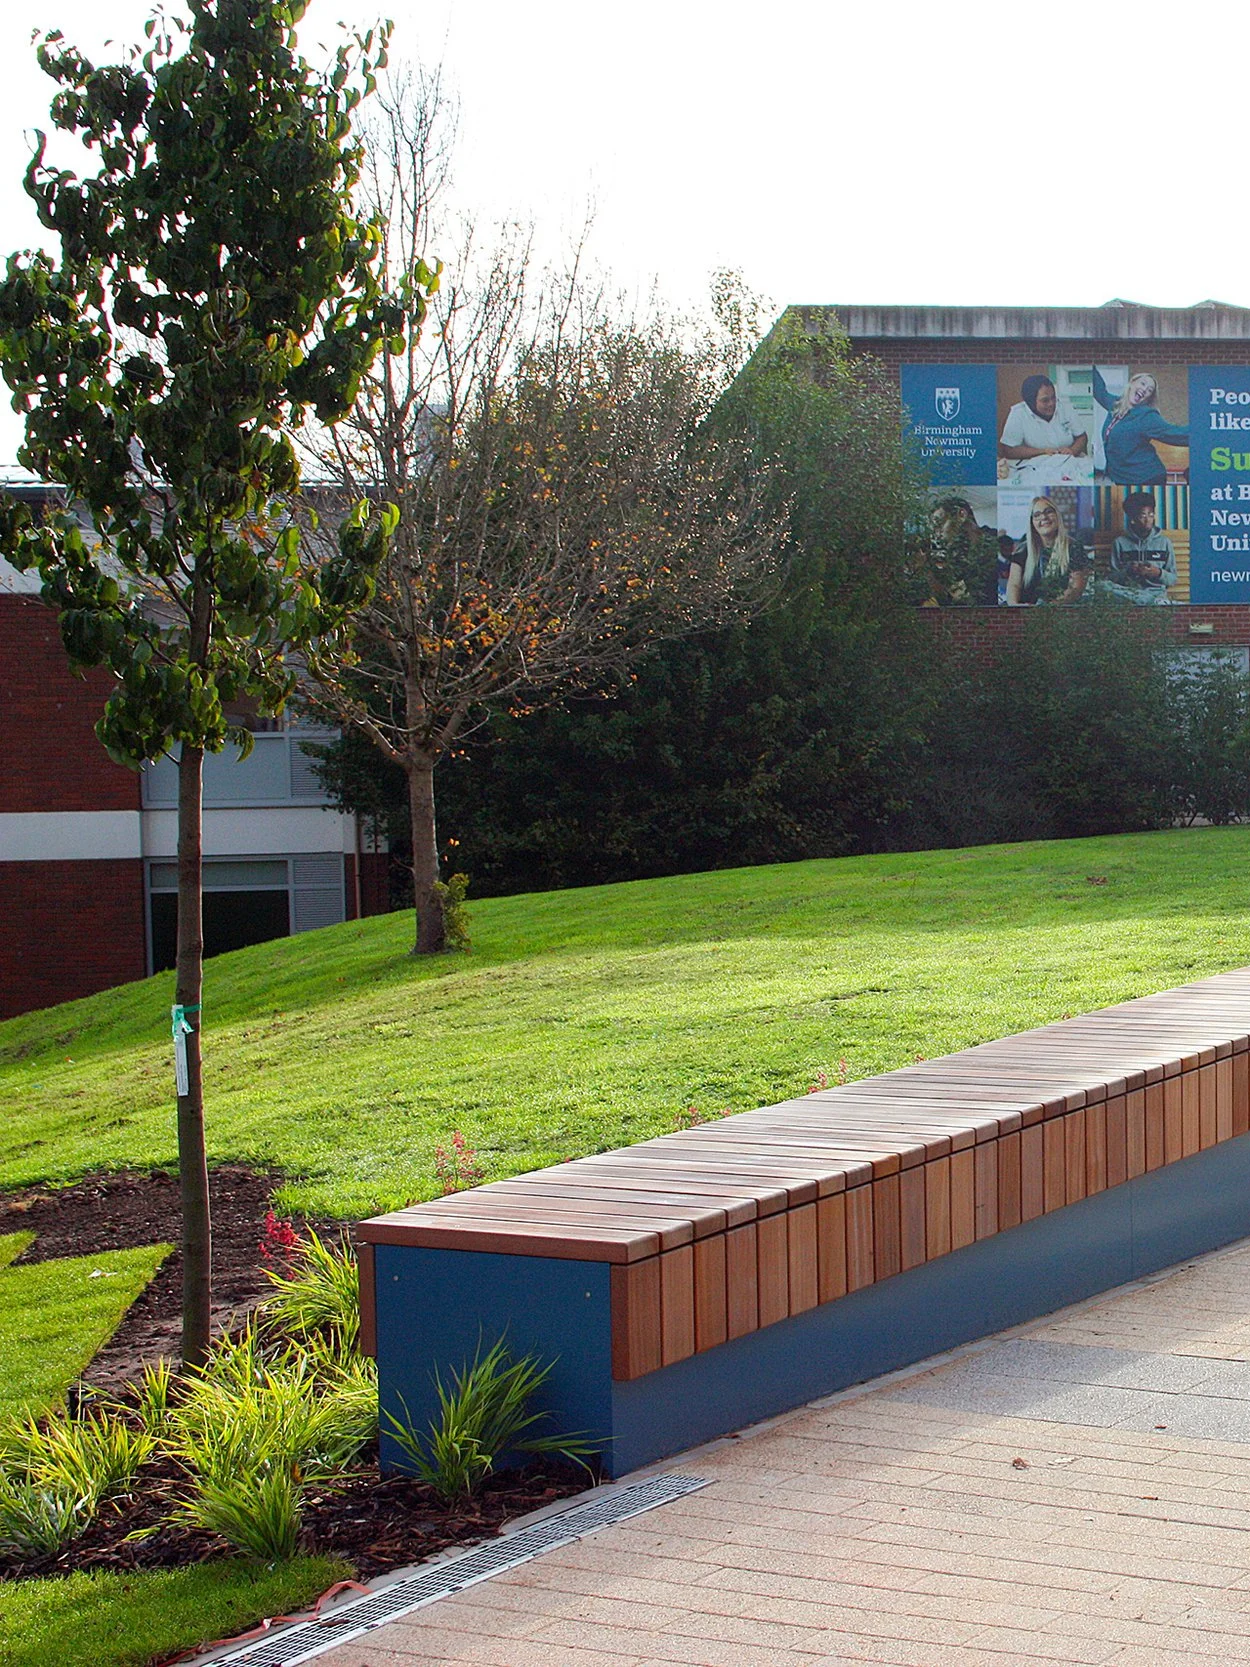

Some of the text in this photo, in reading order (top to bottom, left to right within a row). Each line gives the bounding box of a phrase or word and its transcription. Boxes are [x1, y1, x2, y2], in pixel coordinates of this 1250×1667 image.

[914, 425, 982, 437] Birmingham
[921, 447, 976, 459] Unversity
[1210, 484, 1233, 501] at
